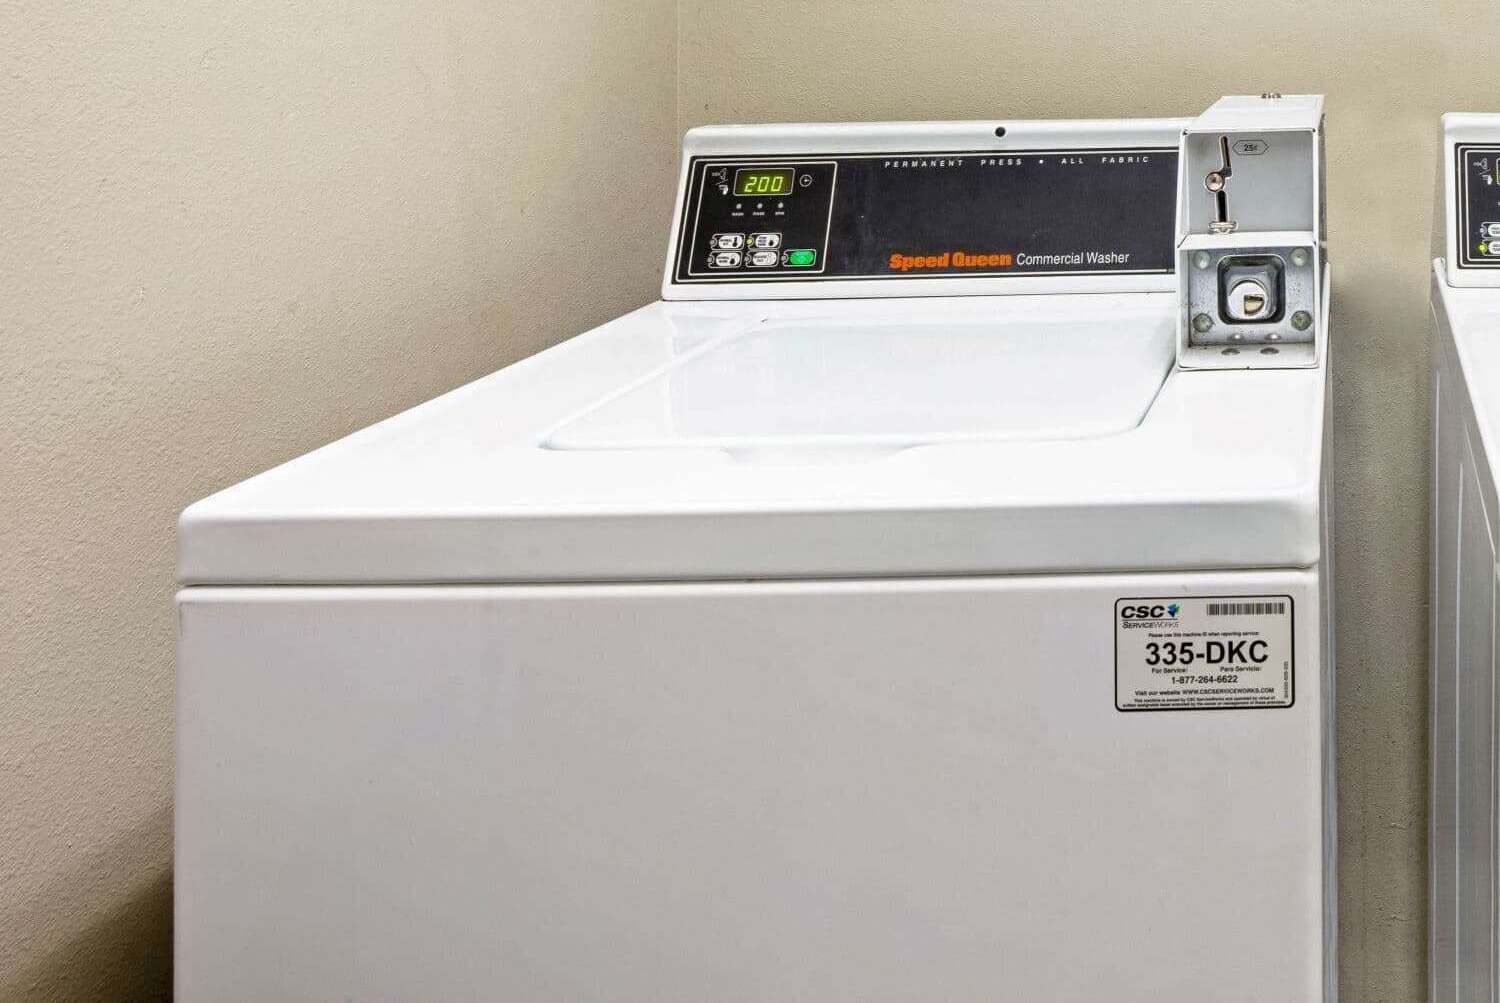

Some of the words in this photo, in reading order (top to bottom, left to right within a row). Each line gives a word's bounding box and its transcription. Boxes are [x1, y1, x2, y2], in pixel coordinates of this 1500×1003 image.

[884, 160, 964, 168] PERMANENT
[980, 158, 1023, 166] PRESS
[1102, 156, 1149, 164] FABRIC
[744, 176, 785, 193] 200
[889, 253, 950, 270] Speed
[952, 251, 1012, 267] Queen
[1016, 253, 1084, 265] Commercial
[1087, 251, 1130, 264] Washer
[1121, 605, 1165, 618] CSC
[1145, 640, 1269, 665] 335-DKC
[1171, 675, 1239, 684] 1-877-264-6622
